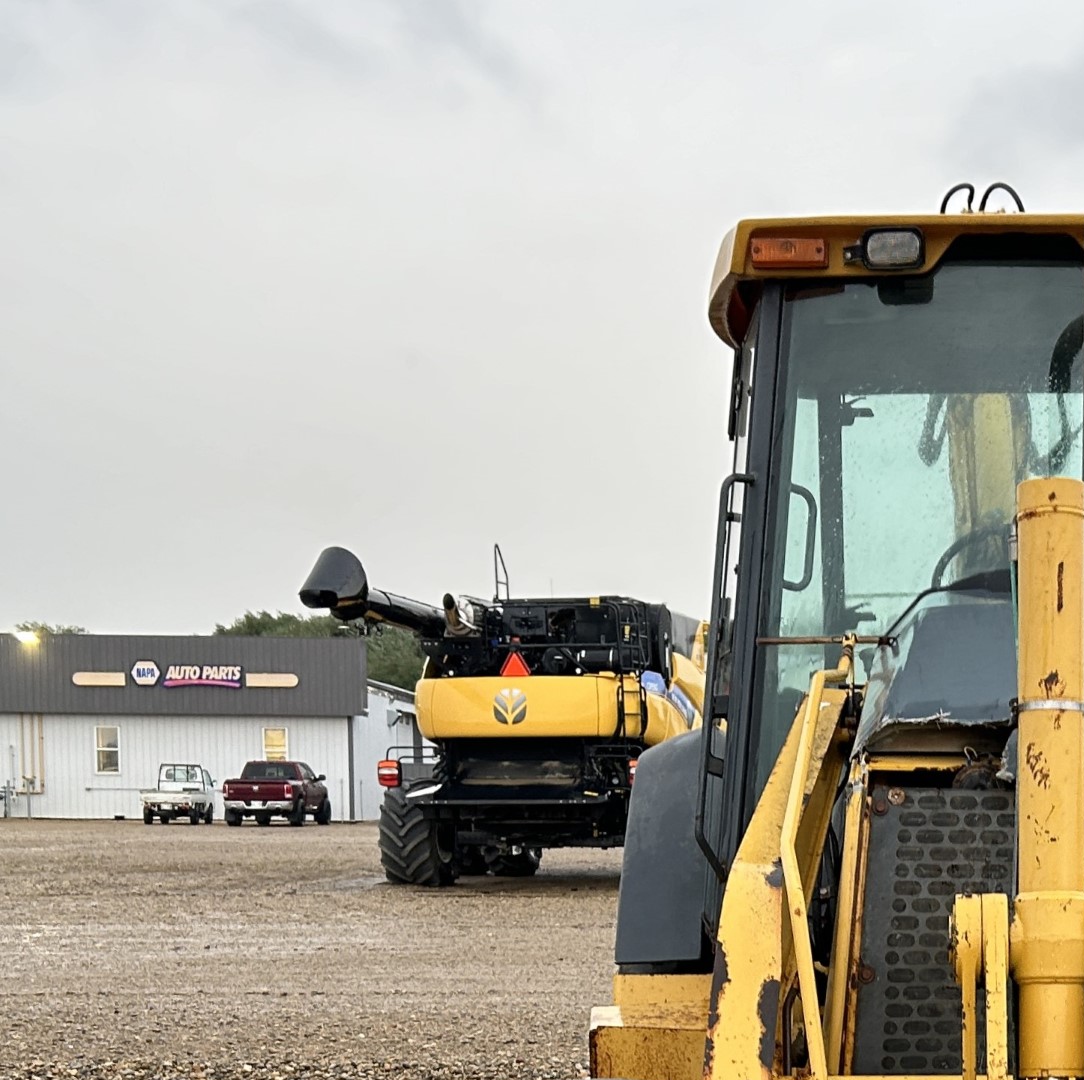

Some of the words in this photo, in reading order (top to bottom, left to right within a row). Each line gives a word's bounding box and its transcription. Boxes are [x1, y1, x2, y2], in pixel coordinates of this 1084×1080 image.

[136, 667, 156, 678] NAPA
[165, 665, 200, 680] AUTO
[202, 665, 242, 680] PARTS
